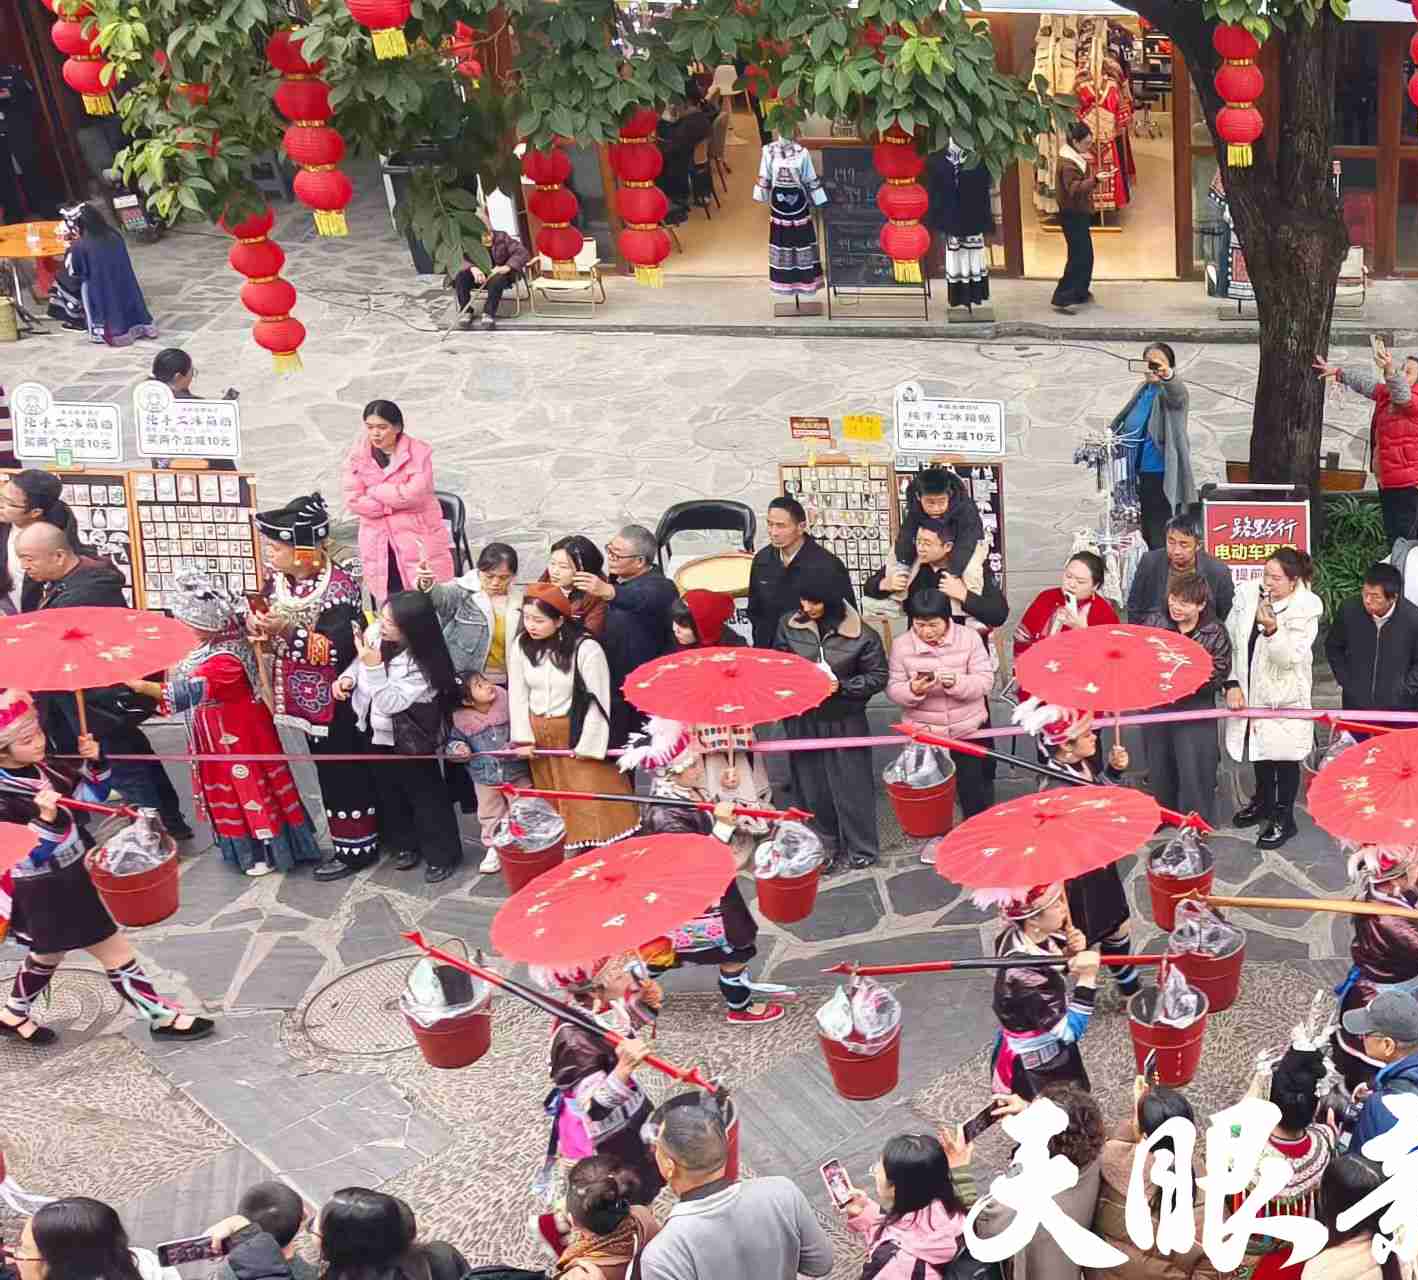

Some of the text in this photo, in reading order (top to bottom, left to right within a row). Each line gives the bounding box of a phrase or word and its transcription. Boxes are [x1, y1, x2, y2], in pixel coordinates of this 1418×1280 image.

[903, 430, 996, 442] 买两个立减10元
[1215, 543, 1297, 561] 电动车租
